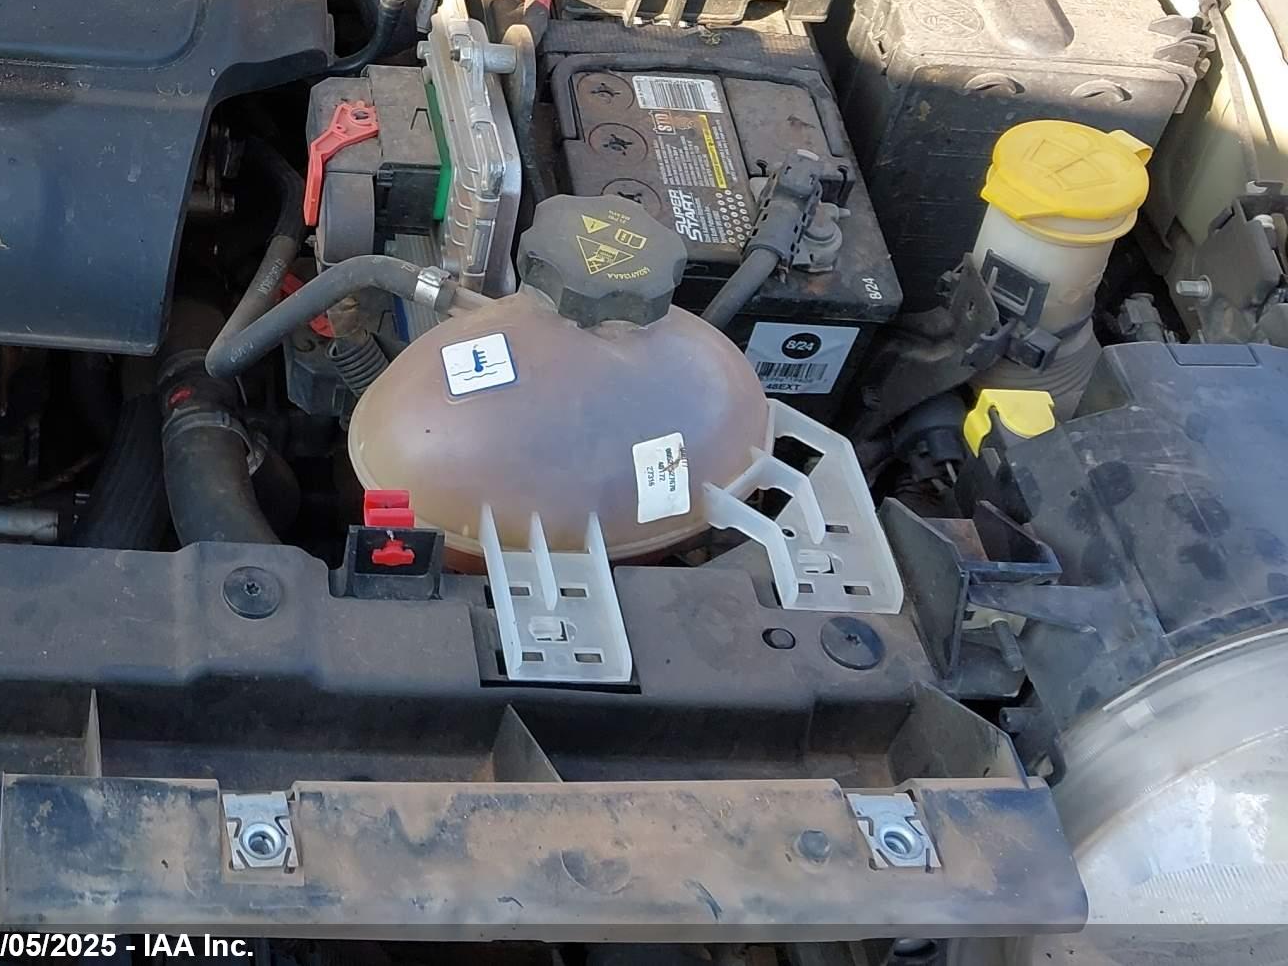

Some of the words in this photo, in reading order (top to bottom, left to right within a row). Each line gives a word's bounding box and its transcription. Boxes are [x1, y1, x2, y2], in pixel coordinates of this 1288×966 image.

[668, 189, 688, 234] SUPER
[678, 189, 704, 242] START
[862, 278, 882, 299] 8/24
[785, 340, 815, 351] 8/24
